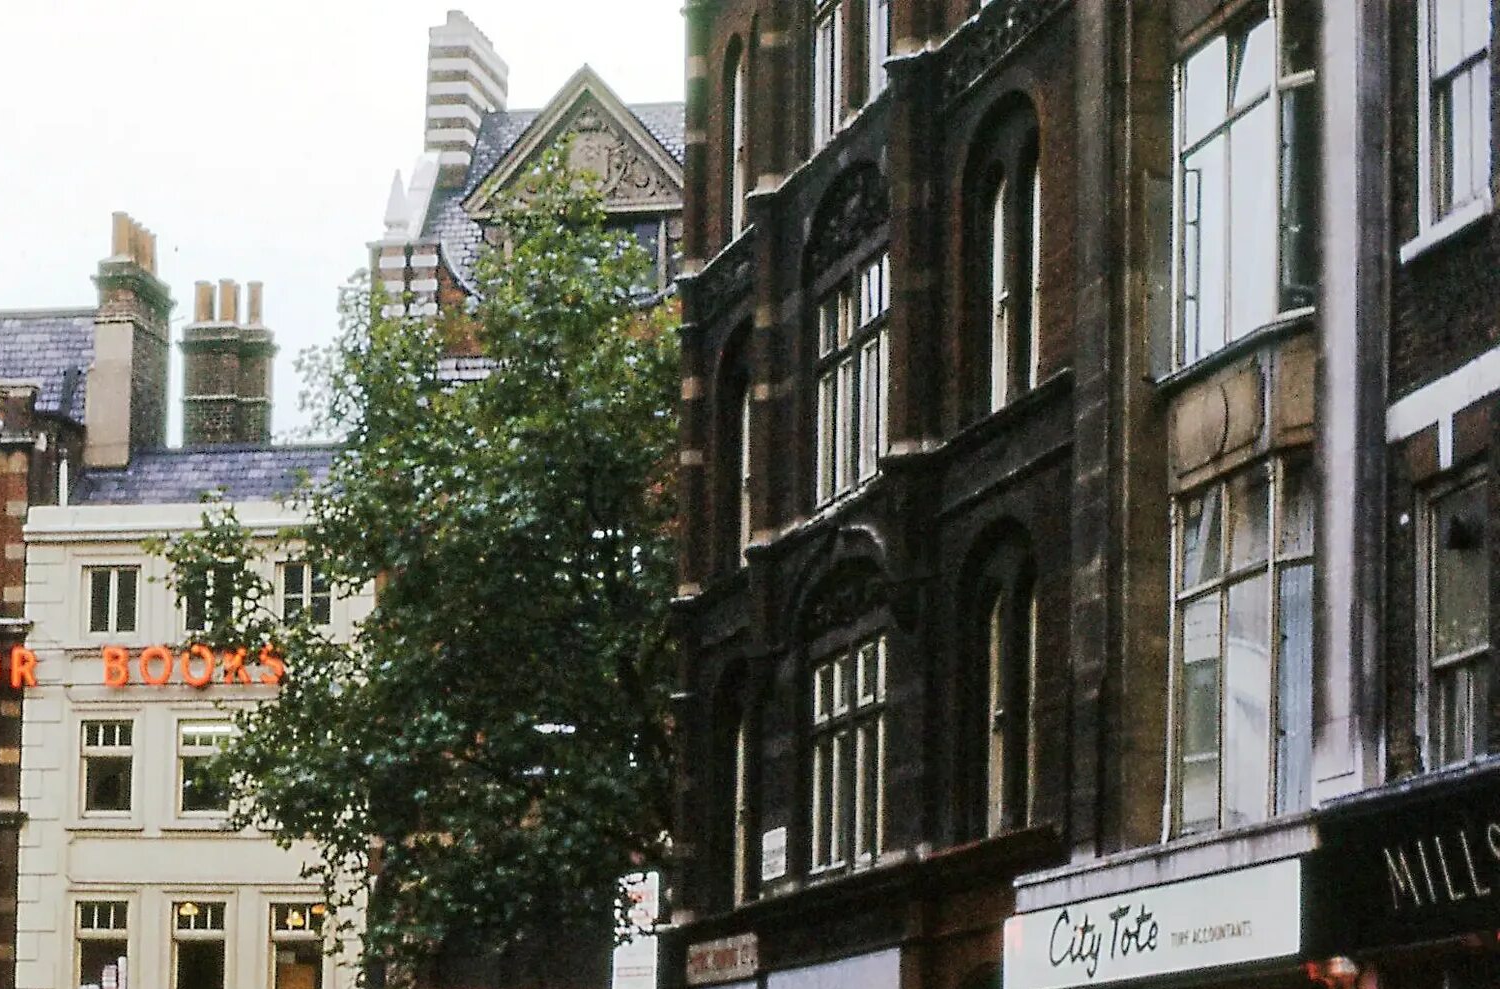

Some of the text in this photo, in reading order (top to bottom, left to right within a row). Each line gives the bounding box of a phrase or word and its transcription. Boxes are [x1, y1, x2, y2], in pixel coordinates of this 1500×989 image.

[102, 643, 286, 688] BOOKS
[1050, 908, 1102, 979] City
[1109, 903, 1159, 960] Tote
